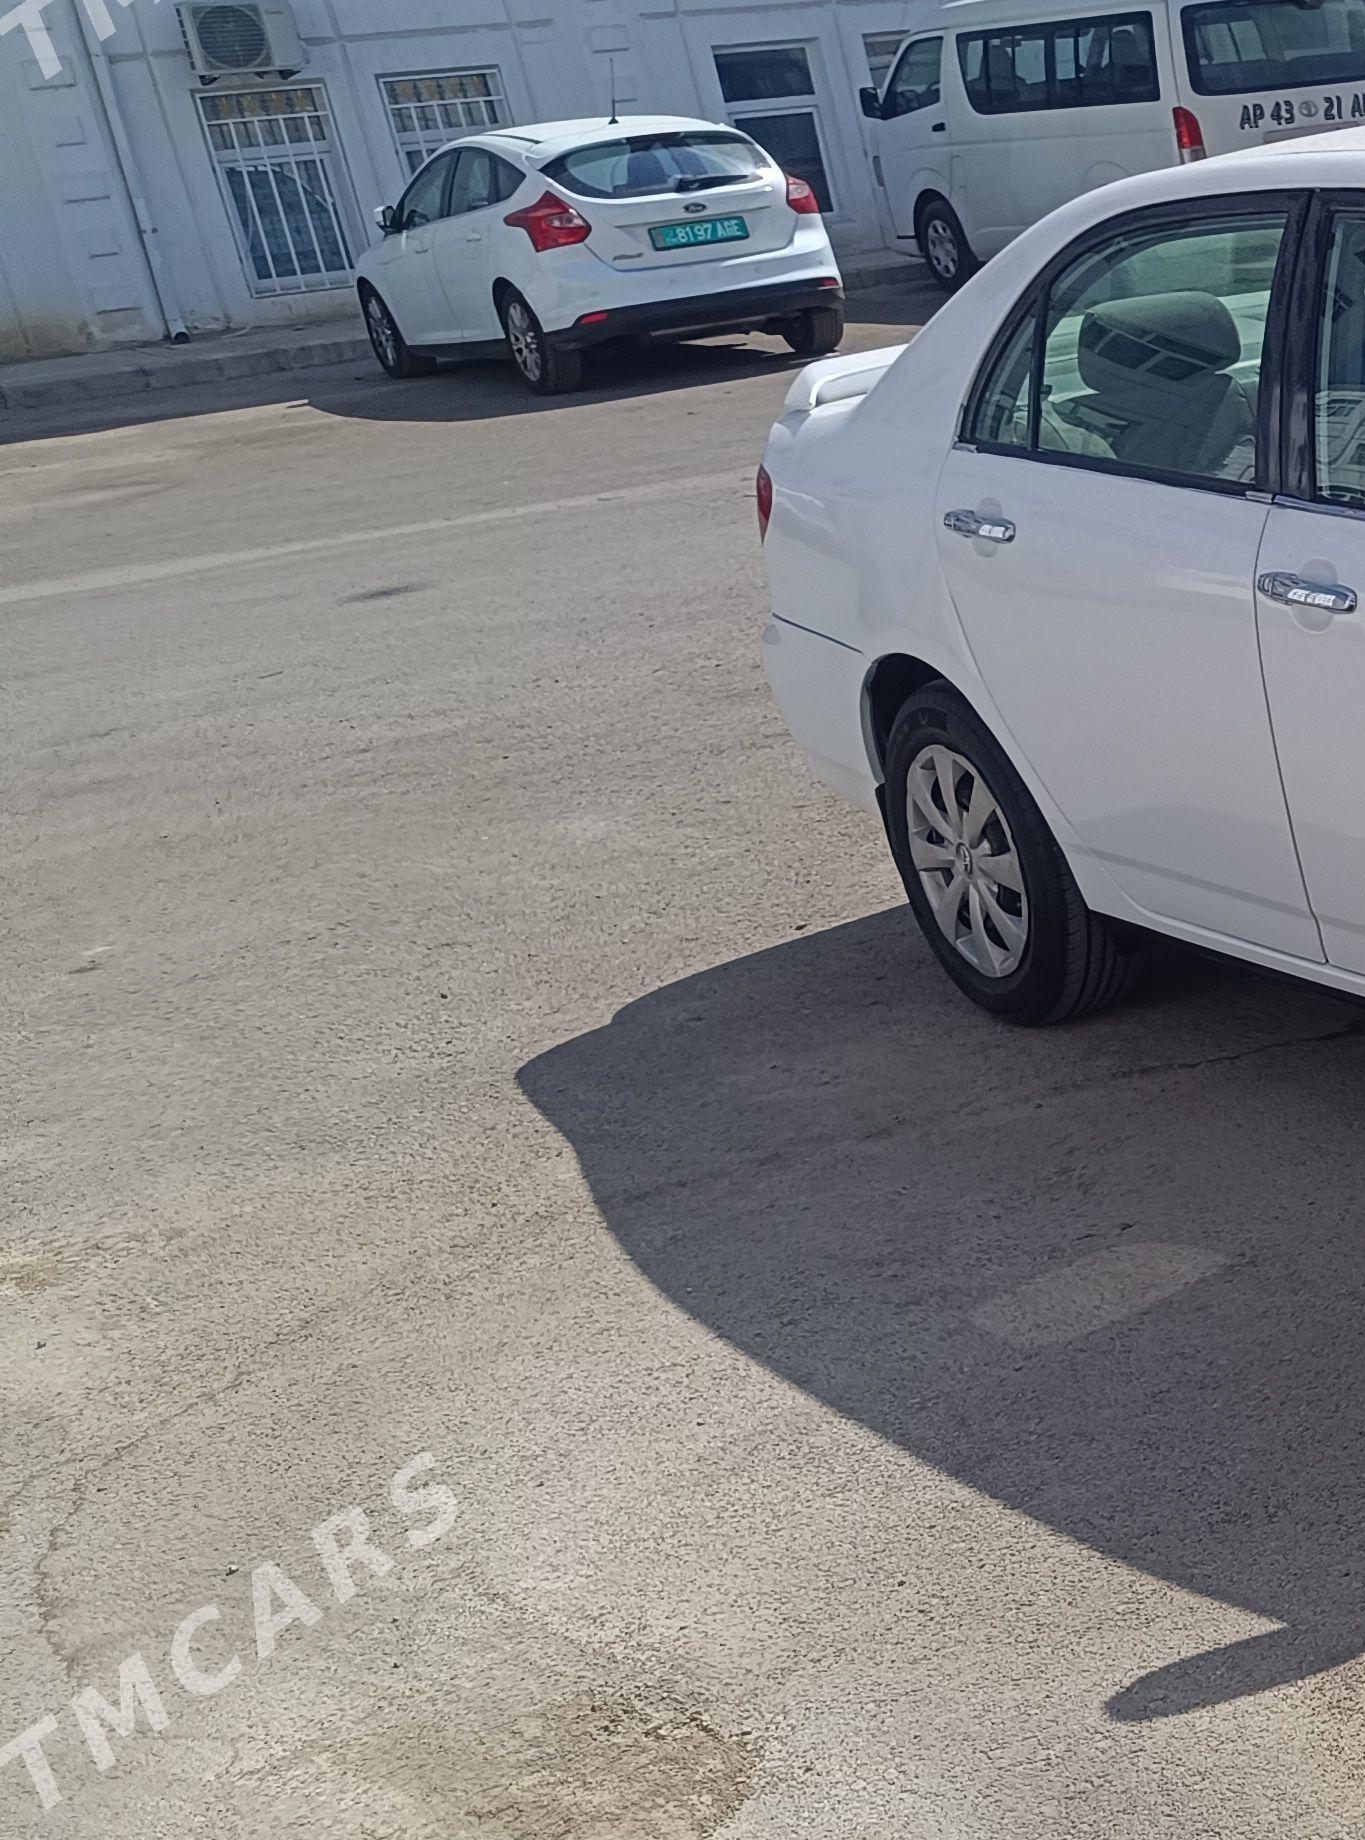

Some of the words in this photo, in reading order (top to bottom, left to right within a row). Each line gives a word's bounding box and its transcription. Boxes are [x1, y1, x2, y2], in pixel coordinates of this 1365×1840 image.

[1239, 103, 1265, 130] AP
[1270, 100, 1295, 126] 43
[1323, 95, 1343, 120] 21
